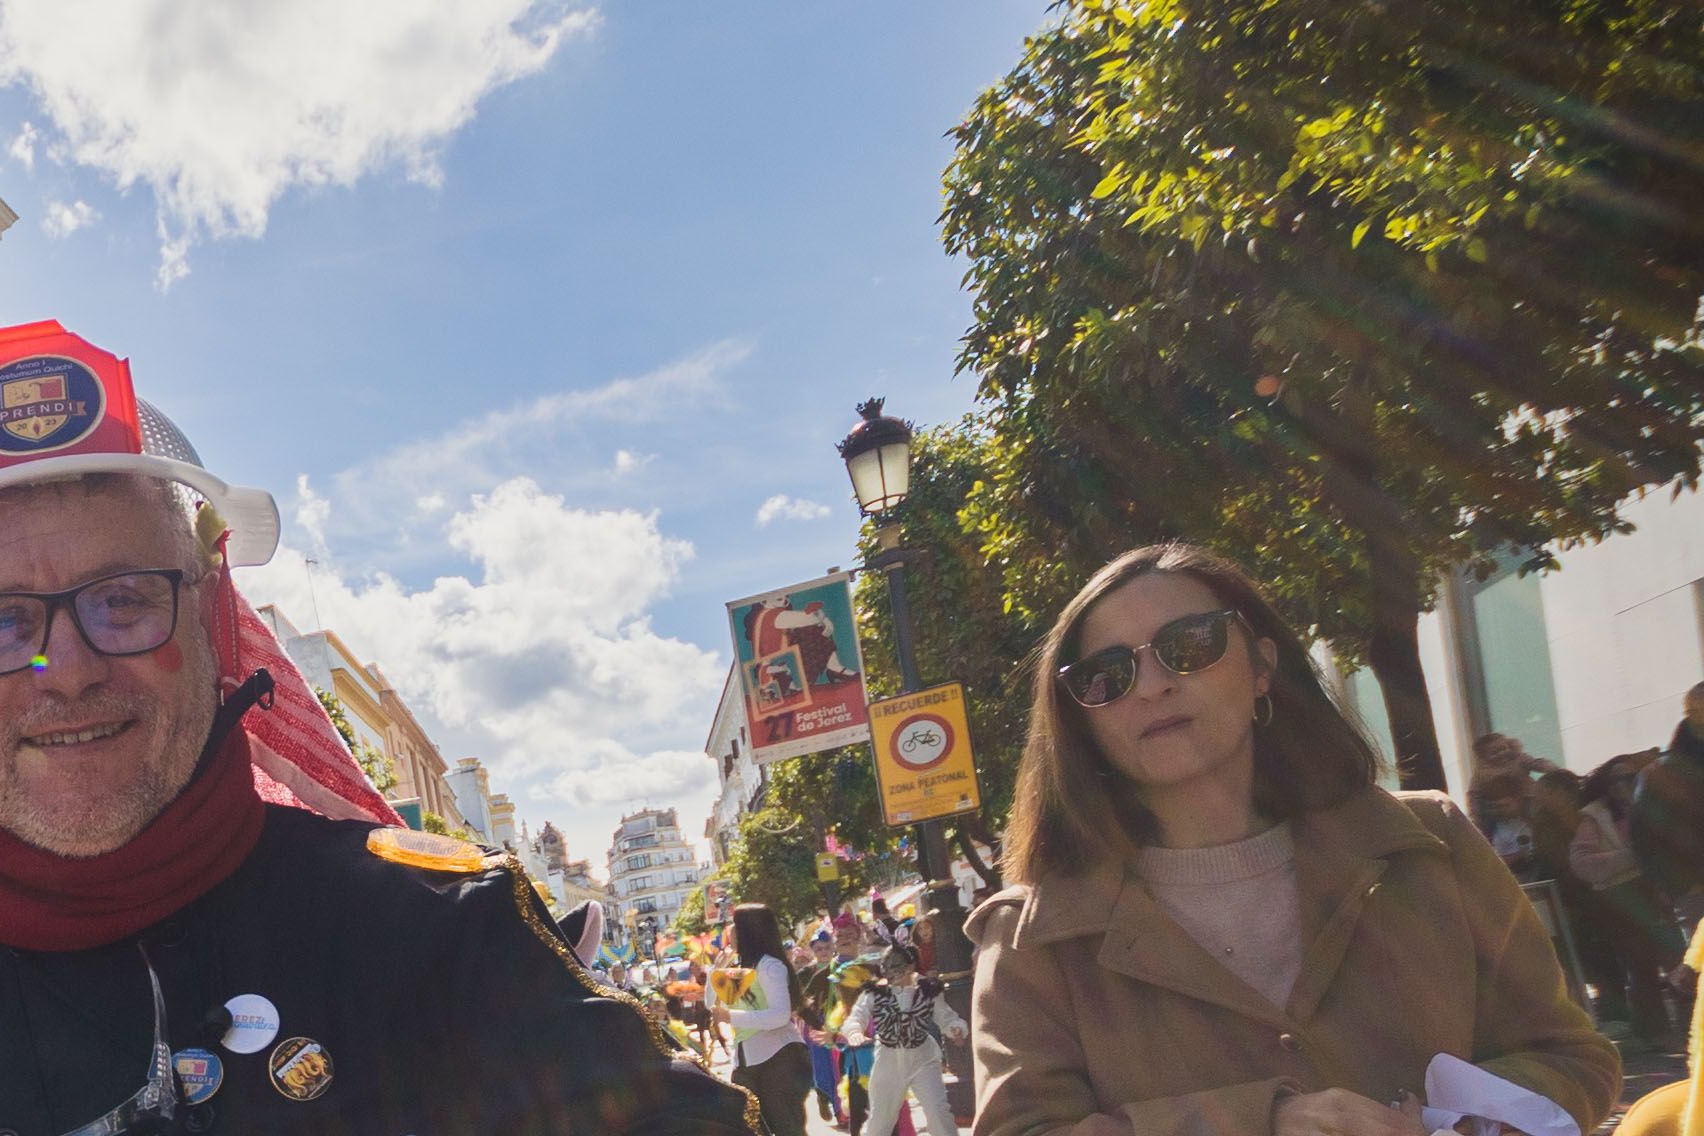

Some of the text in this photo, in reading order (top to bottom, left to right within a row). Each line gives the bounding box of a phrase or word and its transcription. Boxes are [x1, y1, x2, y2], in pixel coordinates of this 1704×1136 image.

[0, 402, 73, 421] PRENDI
[796, 703, 847, 723] Festival
[797, 712, 853, 732] de Jerez
